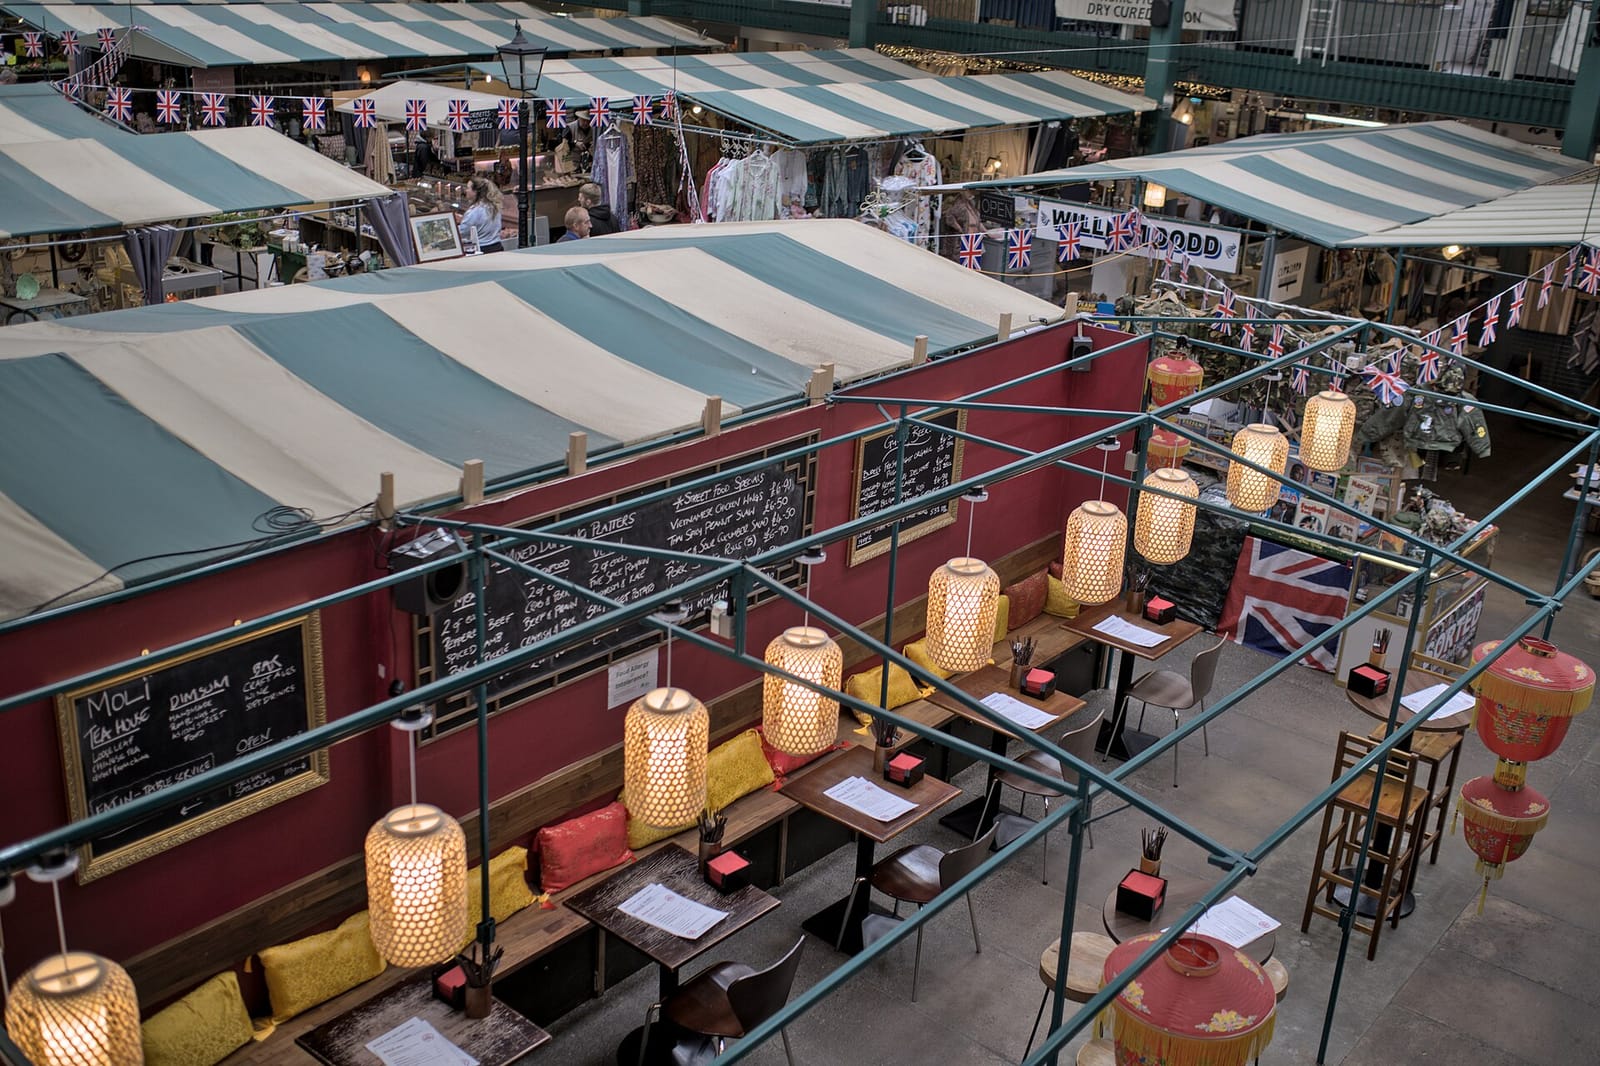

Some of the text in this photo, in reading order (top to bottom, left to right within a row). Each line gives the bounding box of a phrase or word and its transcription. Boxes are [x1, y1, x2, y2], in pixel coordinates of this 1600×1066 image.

[1087, 2, 1152, 20] DRY CURED
[982, 197, 1012, 219] OPEN
[1053, 209, 1222, 259] WILL DODD
[591, 511, 637, 538] PLATTERS
[441, 612, 515, 654] PEPPERE BEEF
[481, 631, 504, 650] AMB
[83, 706, 151, 750] TEA HOUSE
[236, 727, 272, 753] OPEN
